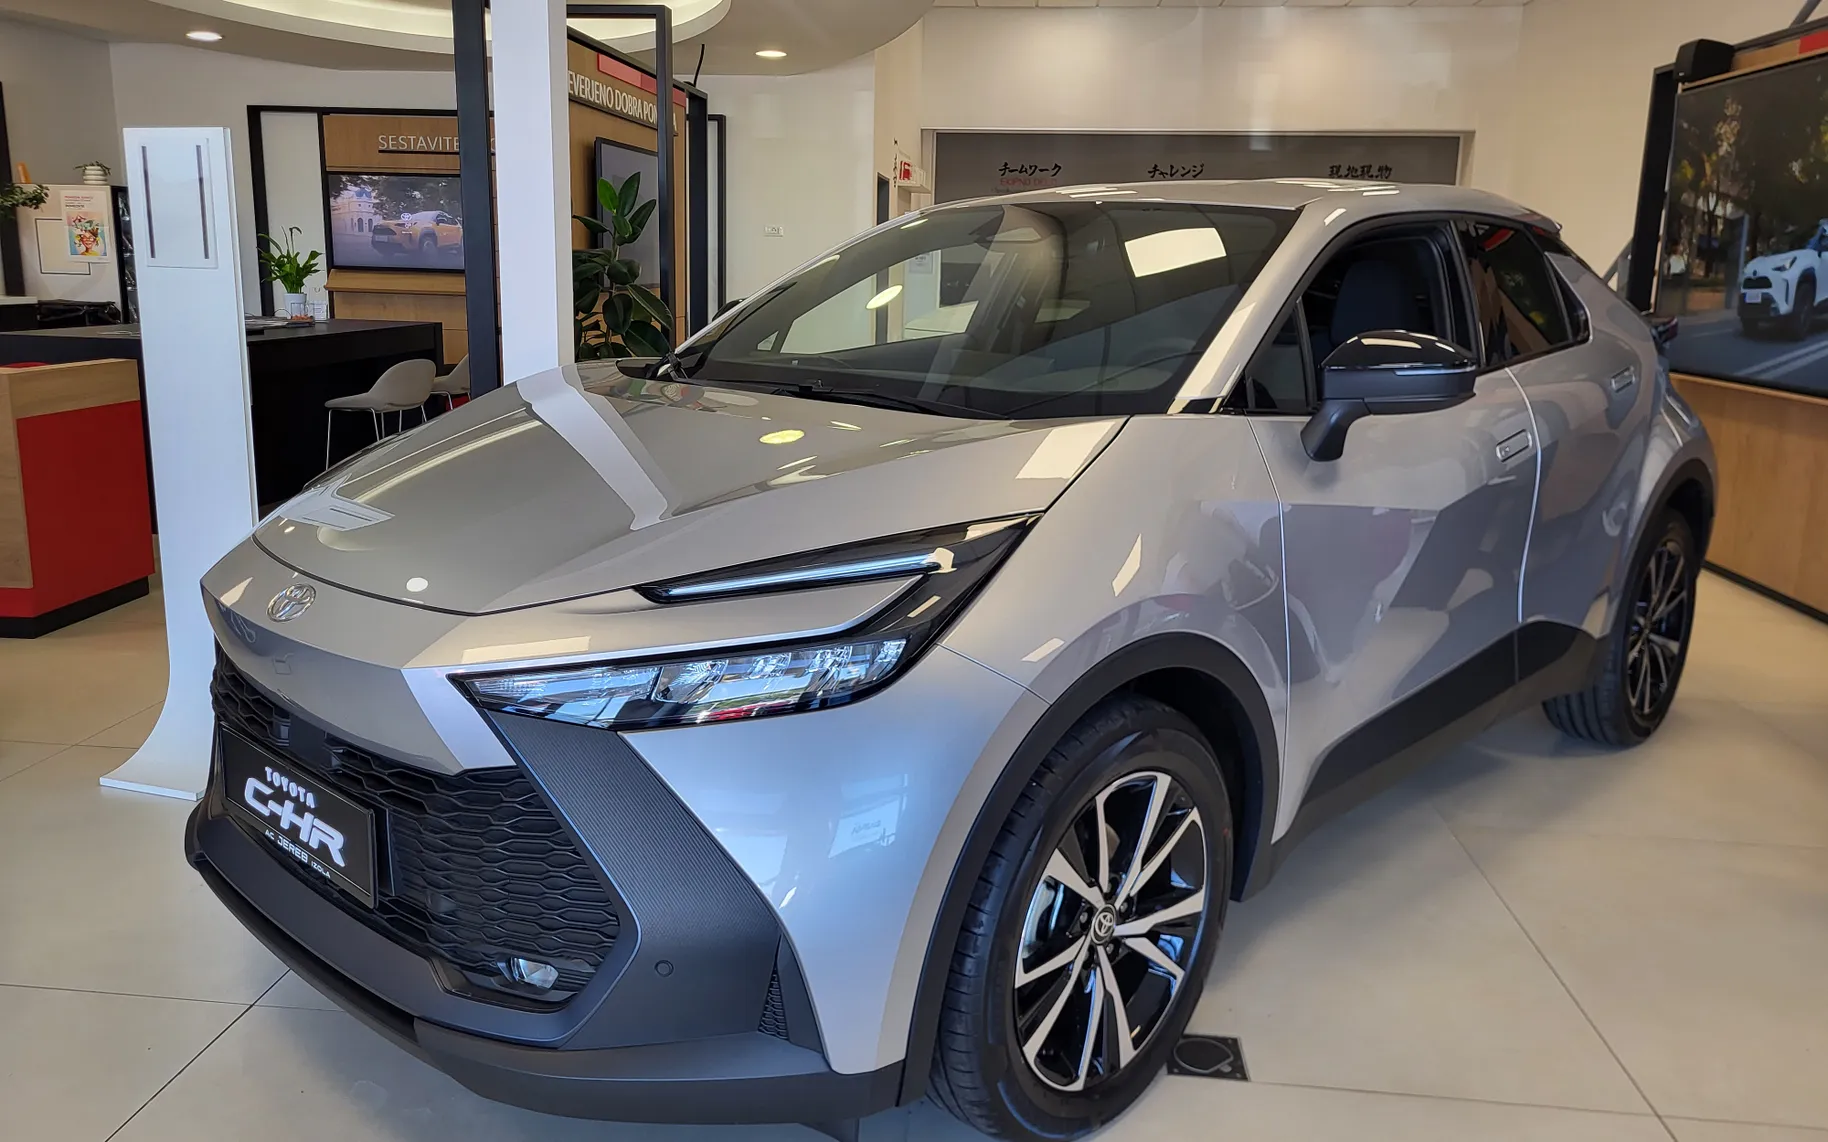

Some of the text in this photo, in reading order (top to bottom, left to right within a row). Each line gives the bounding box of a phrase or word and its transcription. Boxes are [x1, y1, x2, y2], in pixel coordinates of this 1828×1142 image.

[615, 89, 643, 120] DOBRA
[998, 161, 1062, 177] チームワーク
[1147, 162, 1205, 178] チャレンジ
[1328, 164, 1393, 179] 現地現物
[264, 766, 316, 809] TOYOTA
[244, 777, 346, 868] C-HR
[277, 835, 309, 864] JEREB
[311, 860, 331, 879] IZOLA
